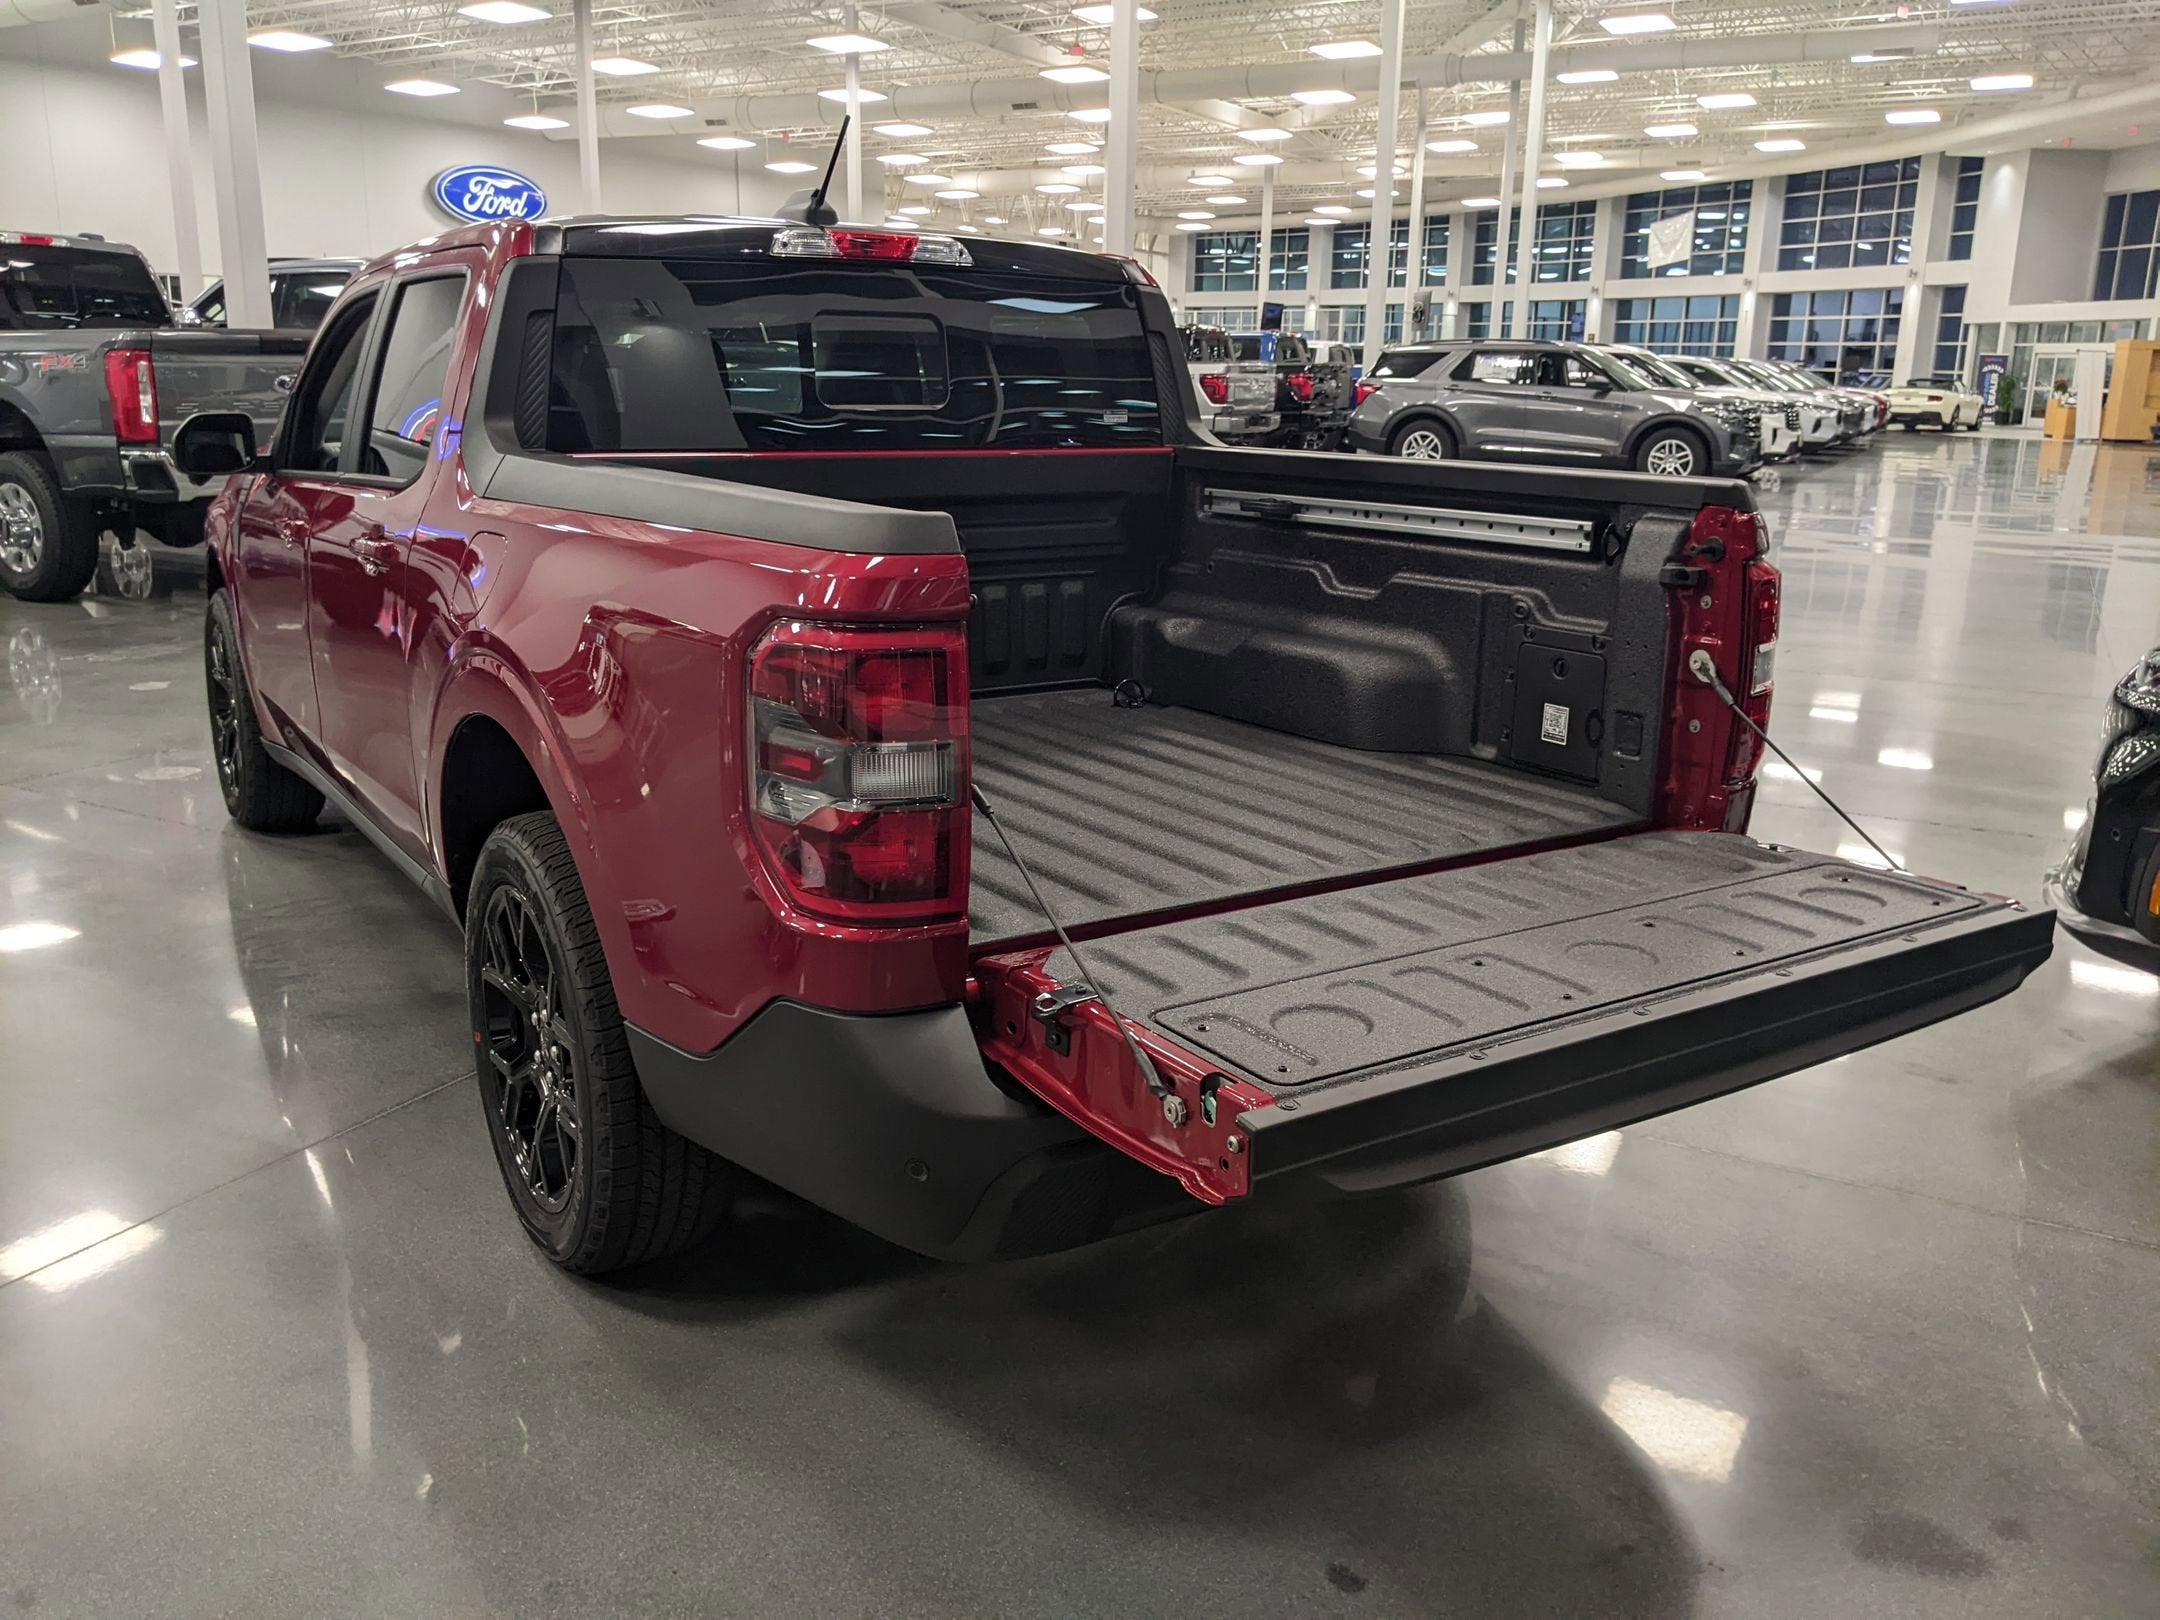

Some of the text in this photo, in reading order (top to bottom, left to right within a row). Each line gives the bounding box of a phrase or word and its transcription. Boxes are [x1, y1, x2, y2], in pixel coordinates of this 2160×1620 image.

[463, 176, 528, 217] Ford
[40, 353, 87, 372] FX4
[1987, 372, 1999, 406] DEALER
